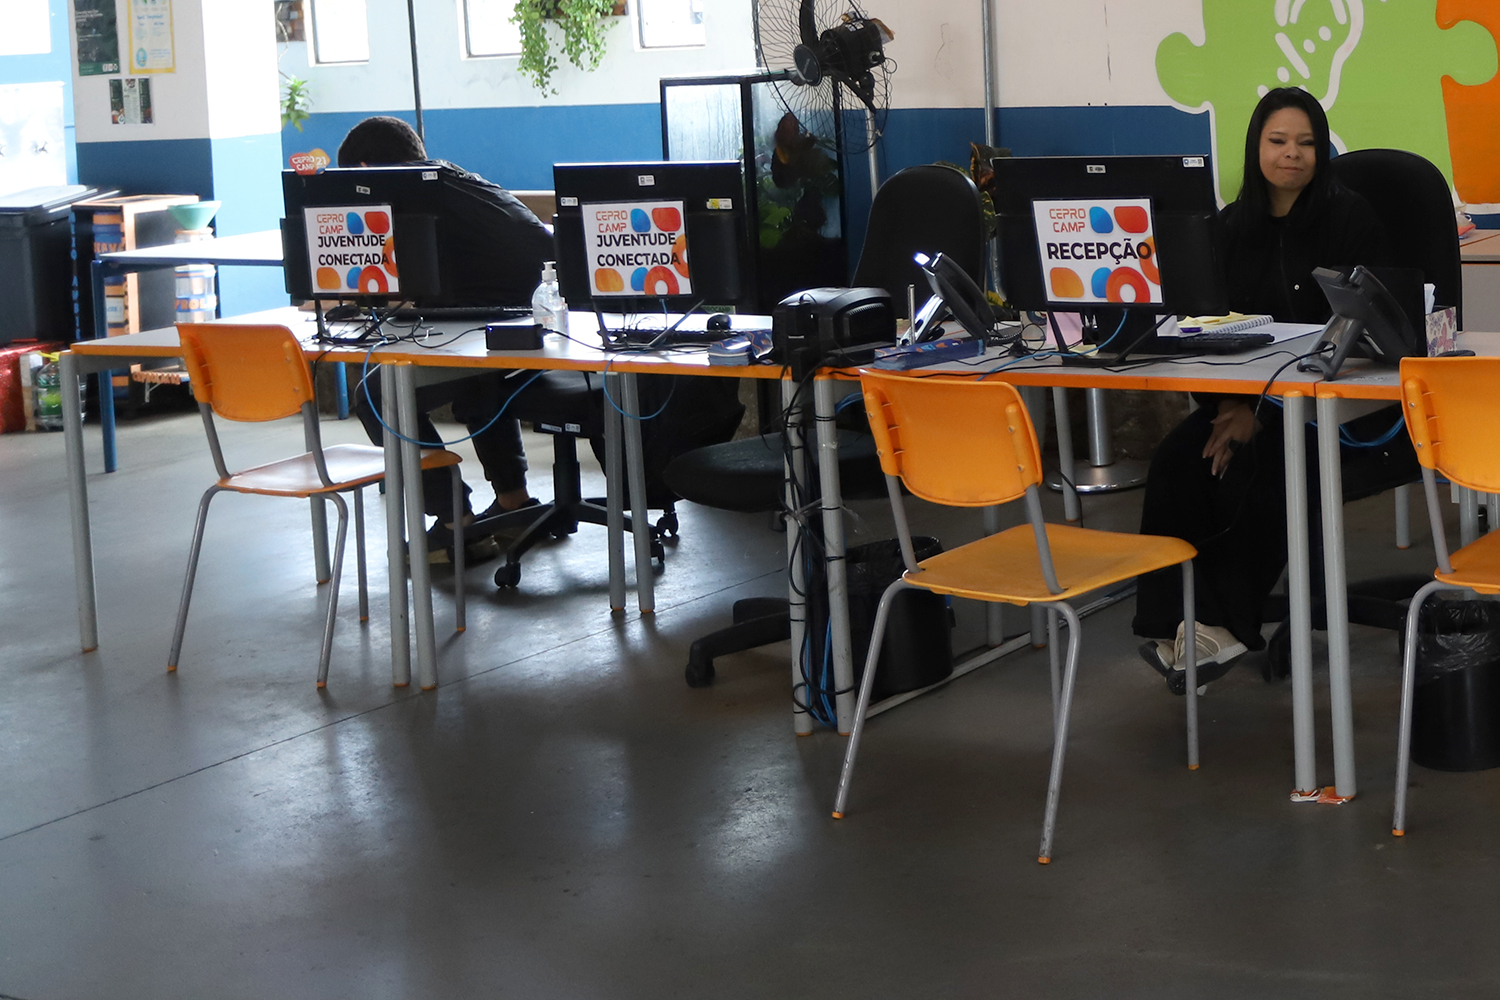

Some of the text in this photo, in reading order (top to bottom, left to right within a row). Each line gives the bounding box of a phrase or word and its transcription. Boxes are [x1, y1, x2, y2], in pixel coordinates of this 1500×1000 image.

[317, 214, 344, 223] CEPRO
[596, 210, 628, 221] CEPRO
[1049, 208, 1086, 219] CEPRO
[320, 225, 343, 234] CAMP
[598, 223, 627, 233] CAMP
[1053, 222, 1085, 232] CAMP
[318, 235, 386, 248] JUVENTUDE
[597, 233, 676, 247] JUVENTUDE
[1047, 238, 1152, 265] RECEPÇÃO
[318, 253, 390, 266] CONECTADA
[597, 253, 681, 267] CONECTADA
